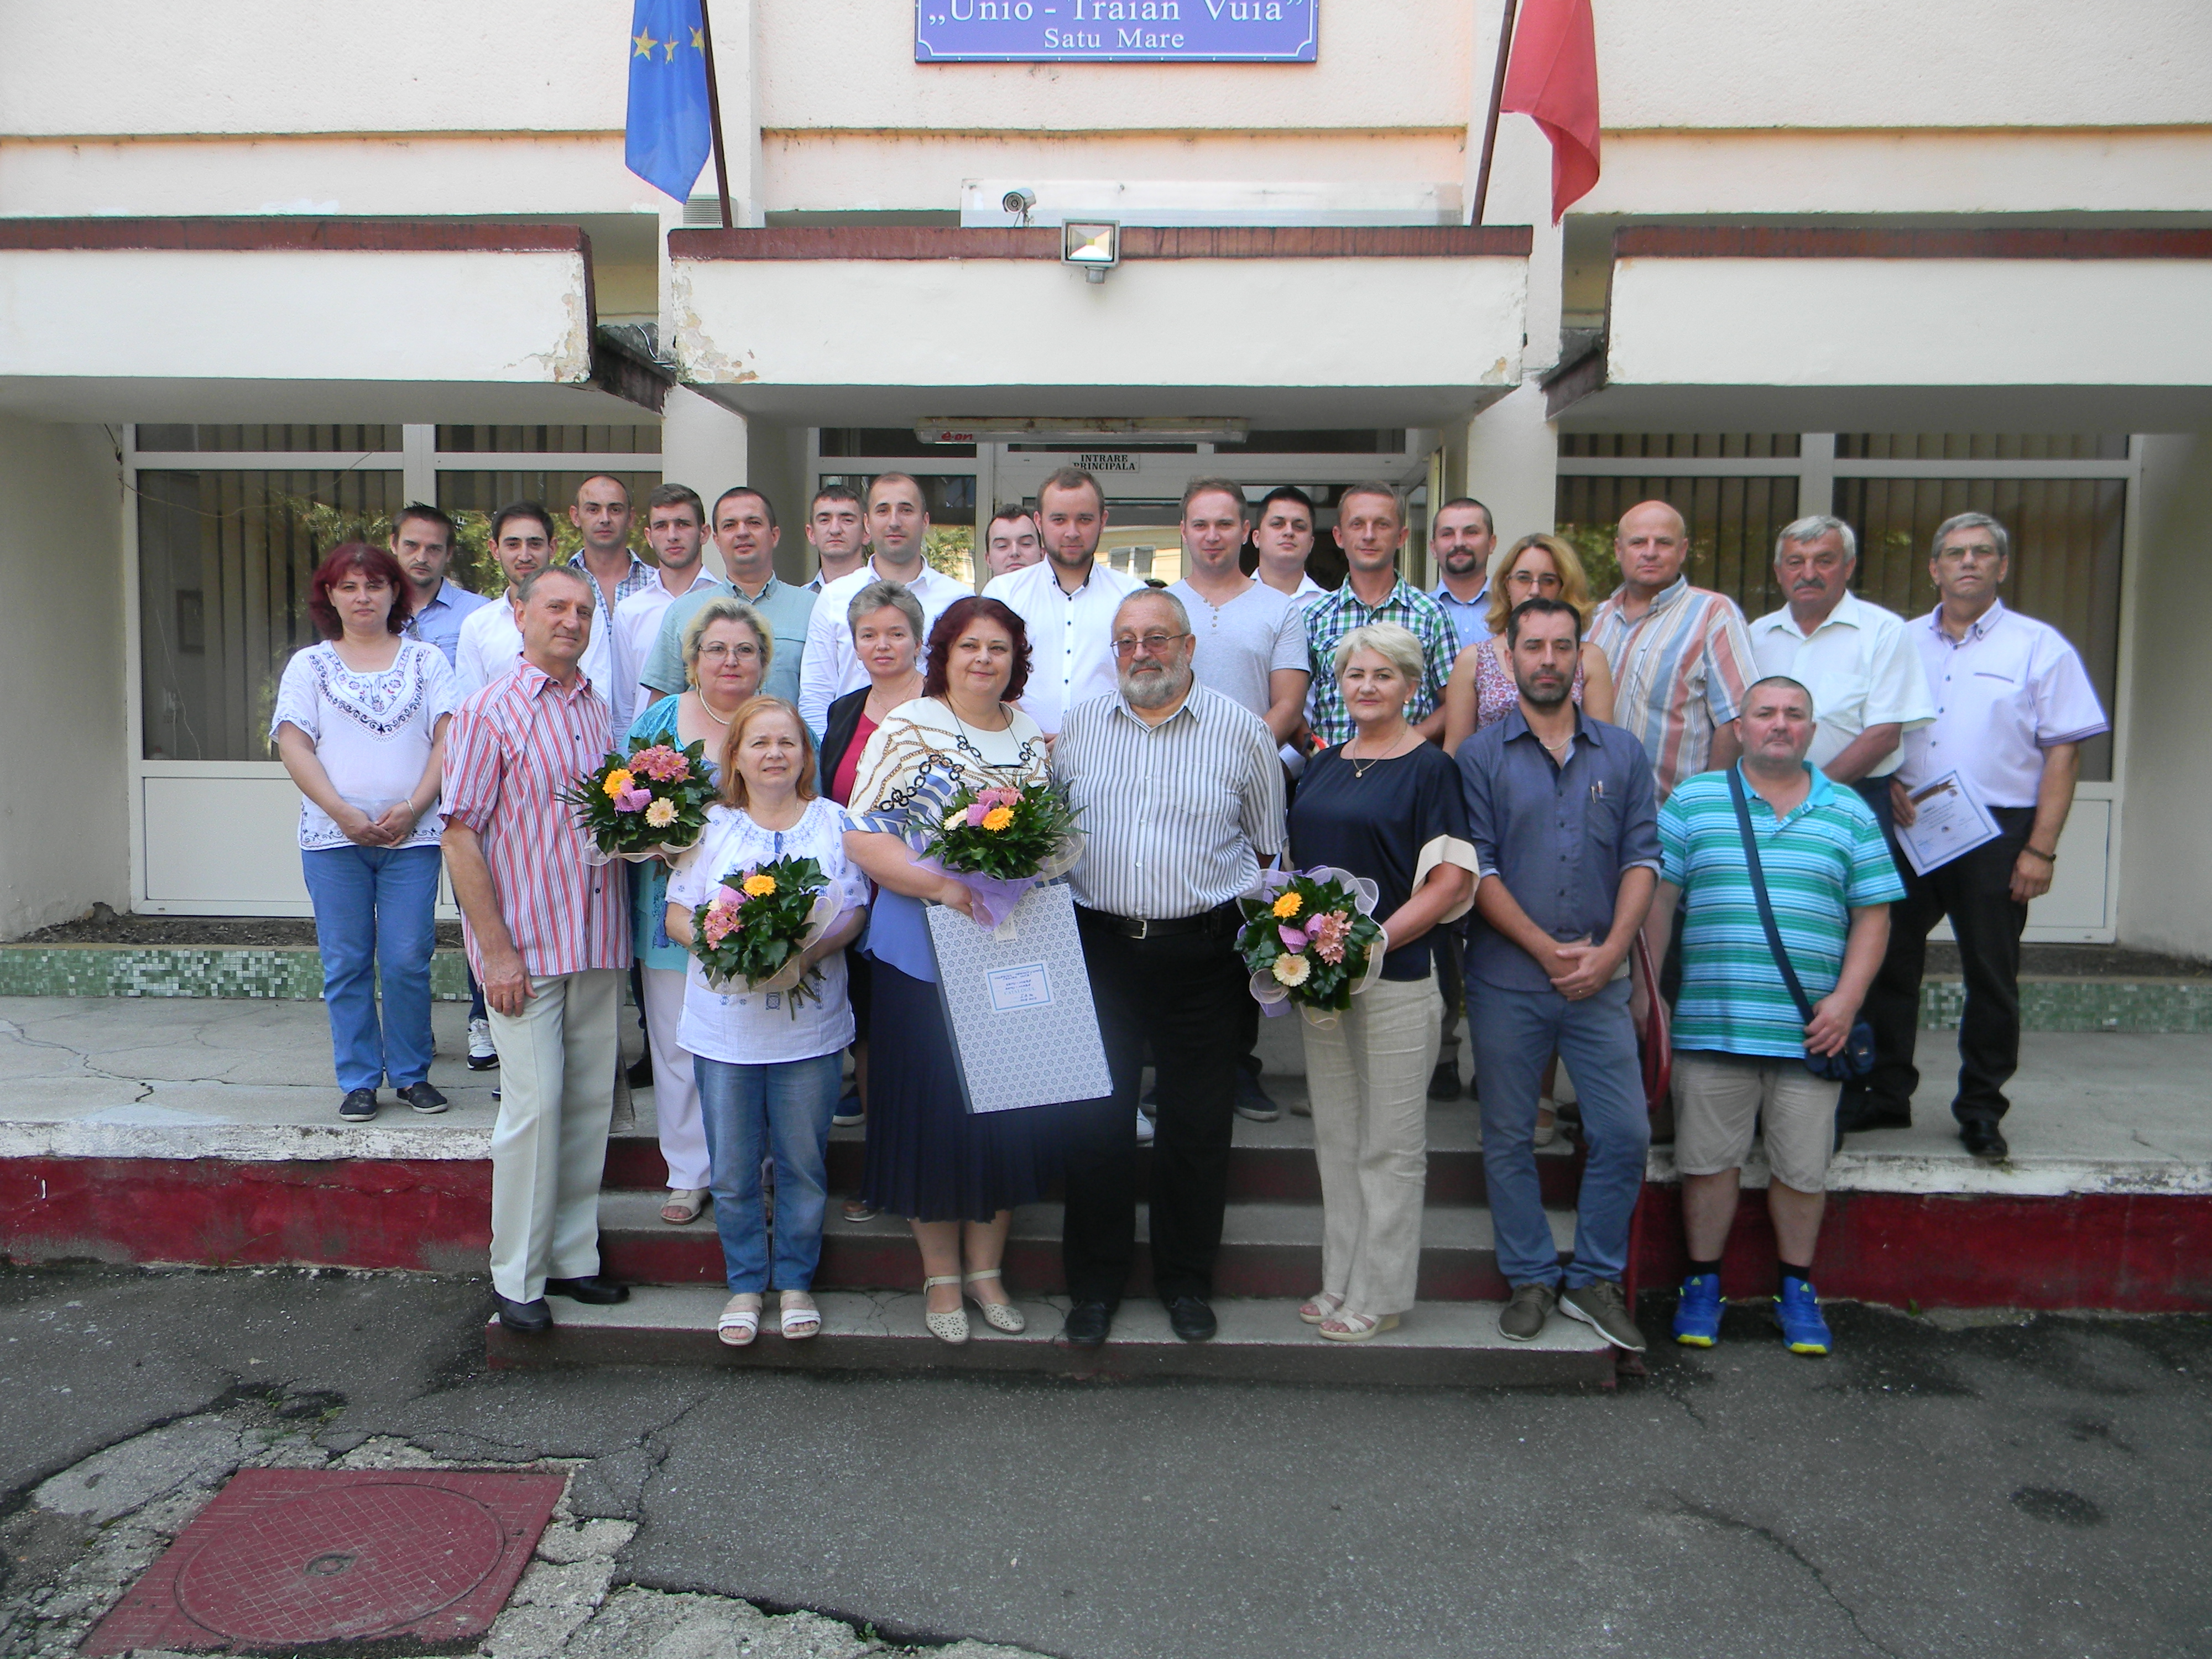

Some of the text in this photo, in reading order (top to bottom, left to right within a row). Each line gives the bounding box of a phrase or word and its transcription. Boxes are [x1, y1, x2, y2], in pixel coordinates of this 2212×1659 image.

[1068, 0, 1181, 21] Traian
[1044, 28, 1184, 49] Satu Mare
